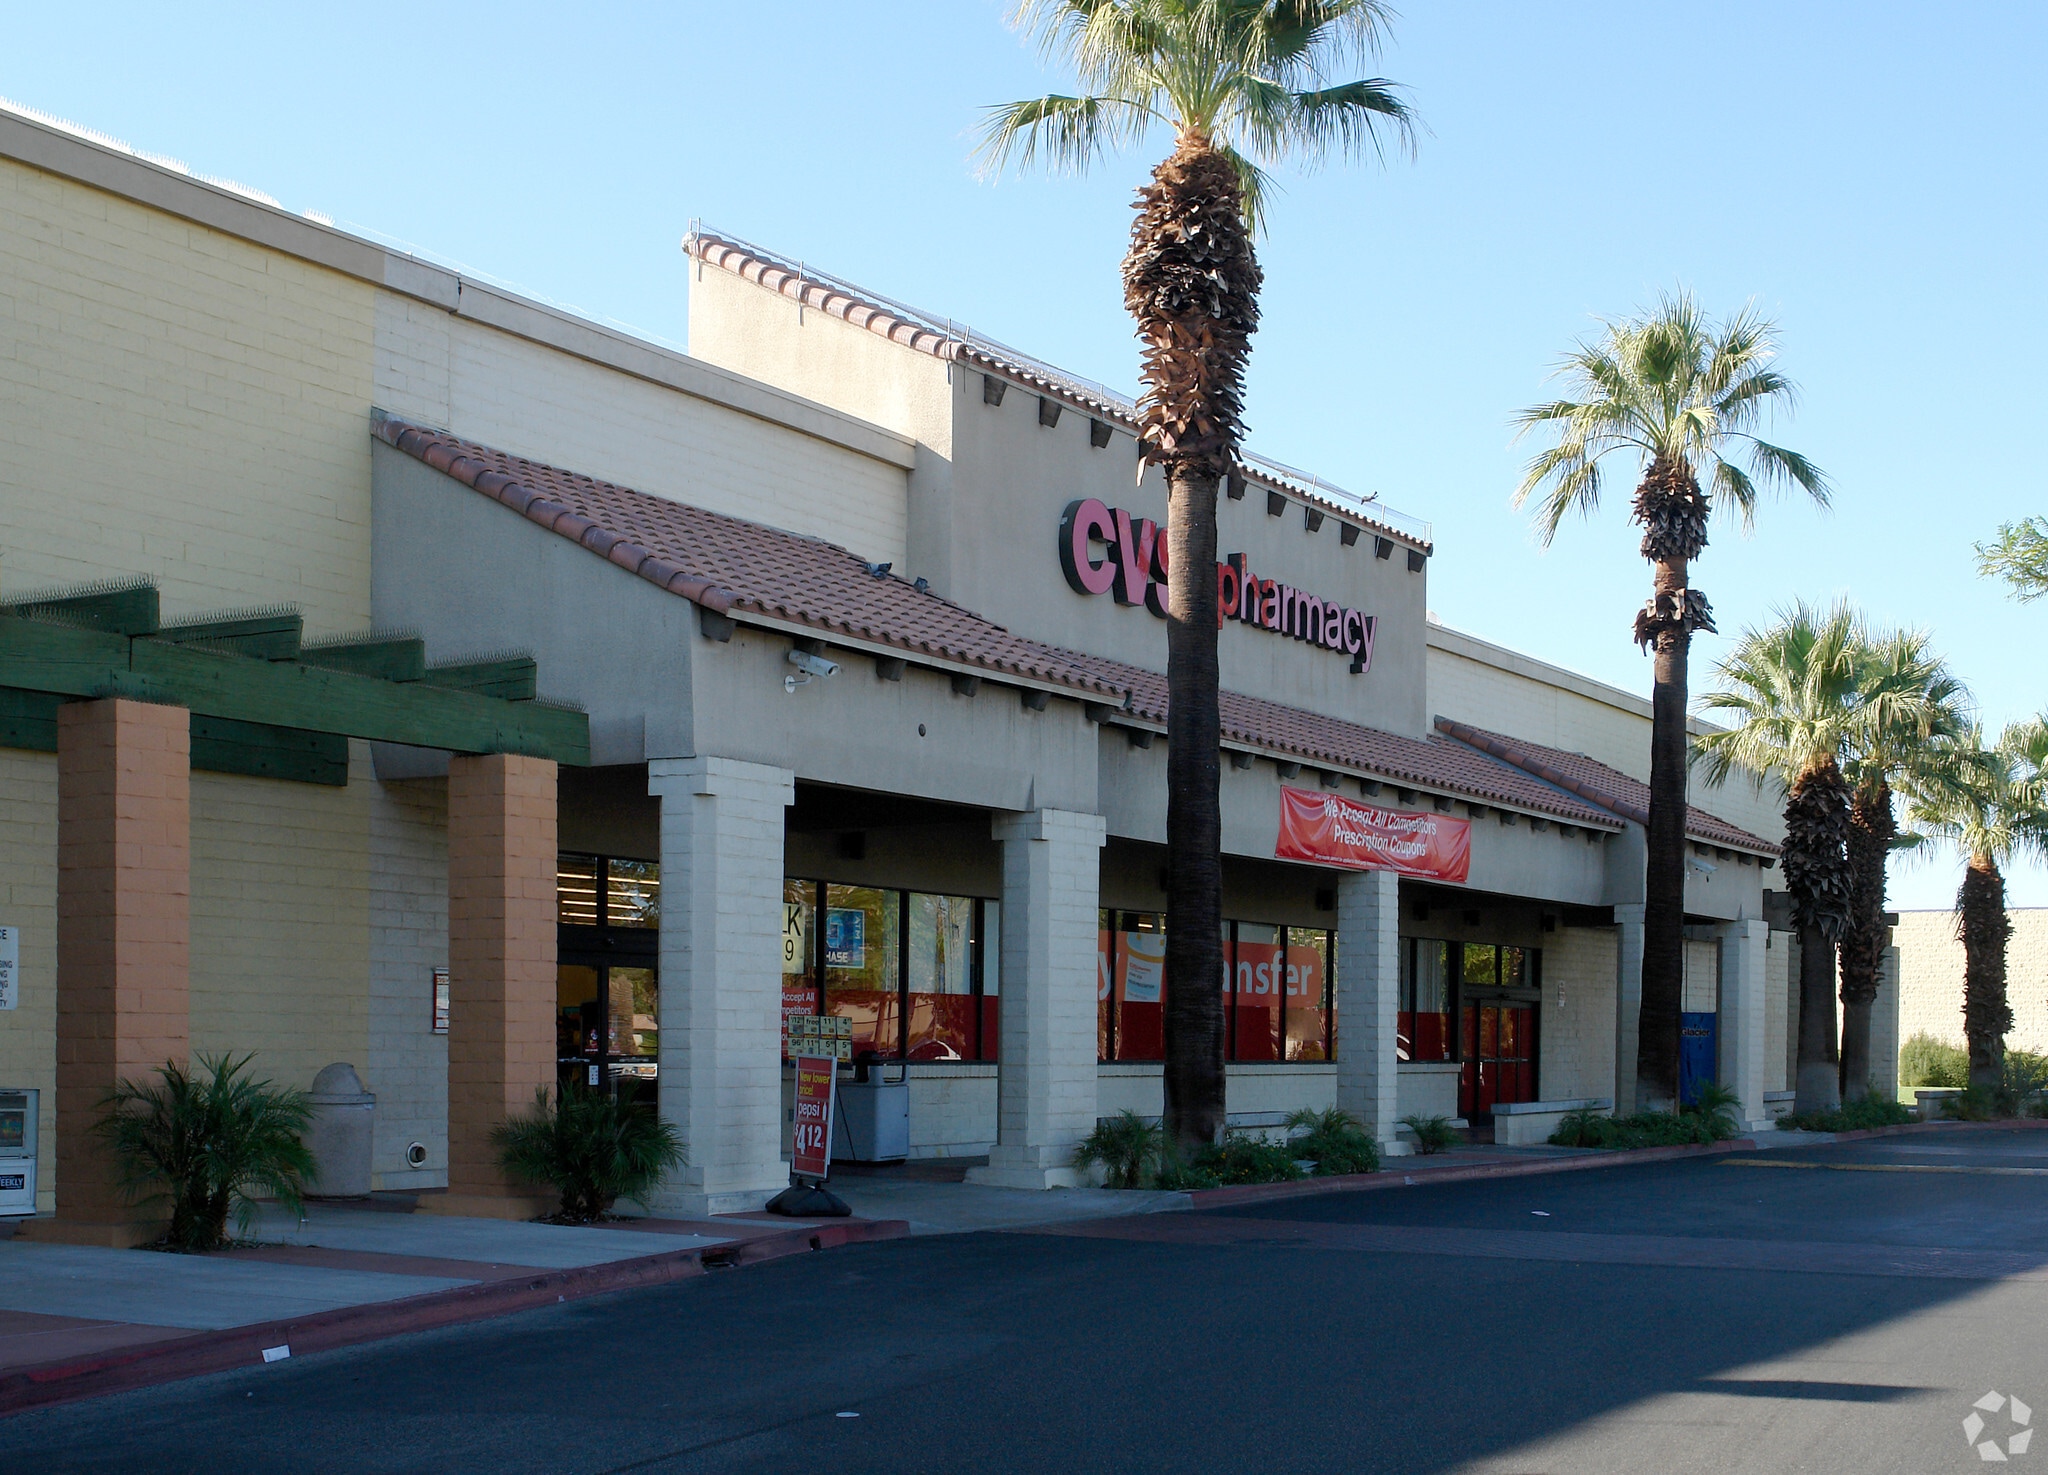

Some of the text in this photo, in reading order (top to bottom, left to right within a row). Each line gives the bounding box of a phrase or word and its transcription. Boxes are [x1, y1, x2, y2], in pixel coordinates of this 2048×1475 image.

[1217, 552, 1378, 674] pharmacy
[1323, 799, 1437, 836] We Accept All Competitors
[1334, 825, 1388, 852] Prescription
[782, 905, 802, 937] K
[853, 915, 862, 940] ATM
[785, 939, 794, 961] 9
[806, 992, 815, 1002] All
[1680, 1027, 1710, 1037] Glacier
[799, 1071, 830, 1084] New lower
[798, 1101, 820, 1118] pepsi
[0, 1177, 23, 1187] EEKLY
